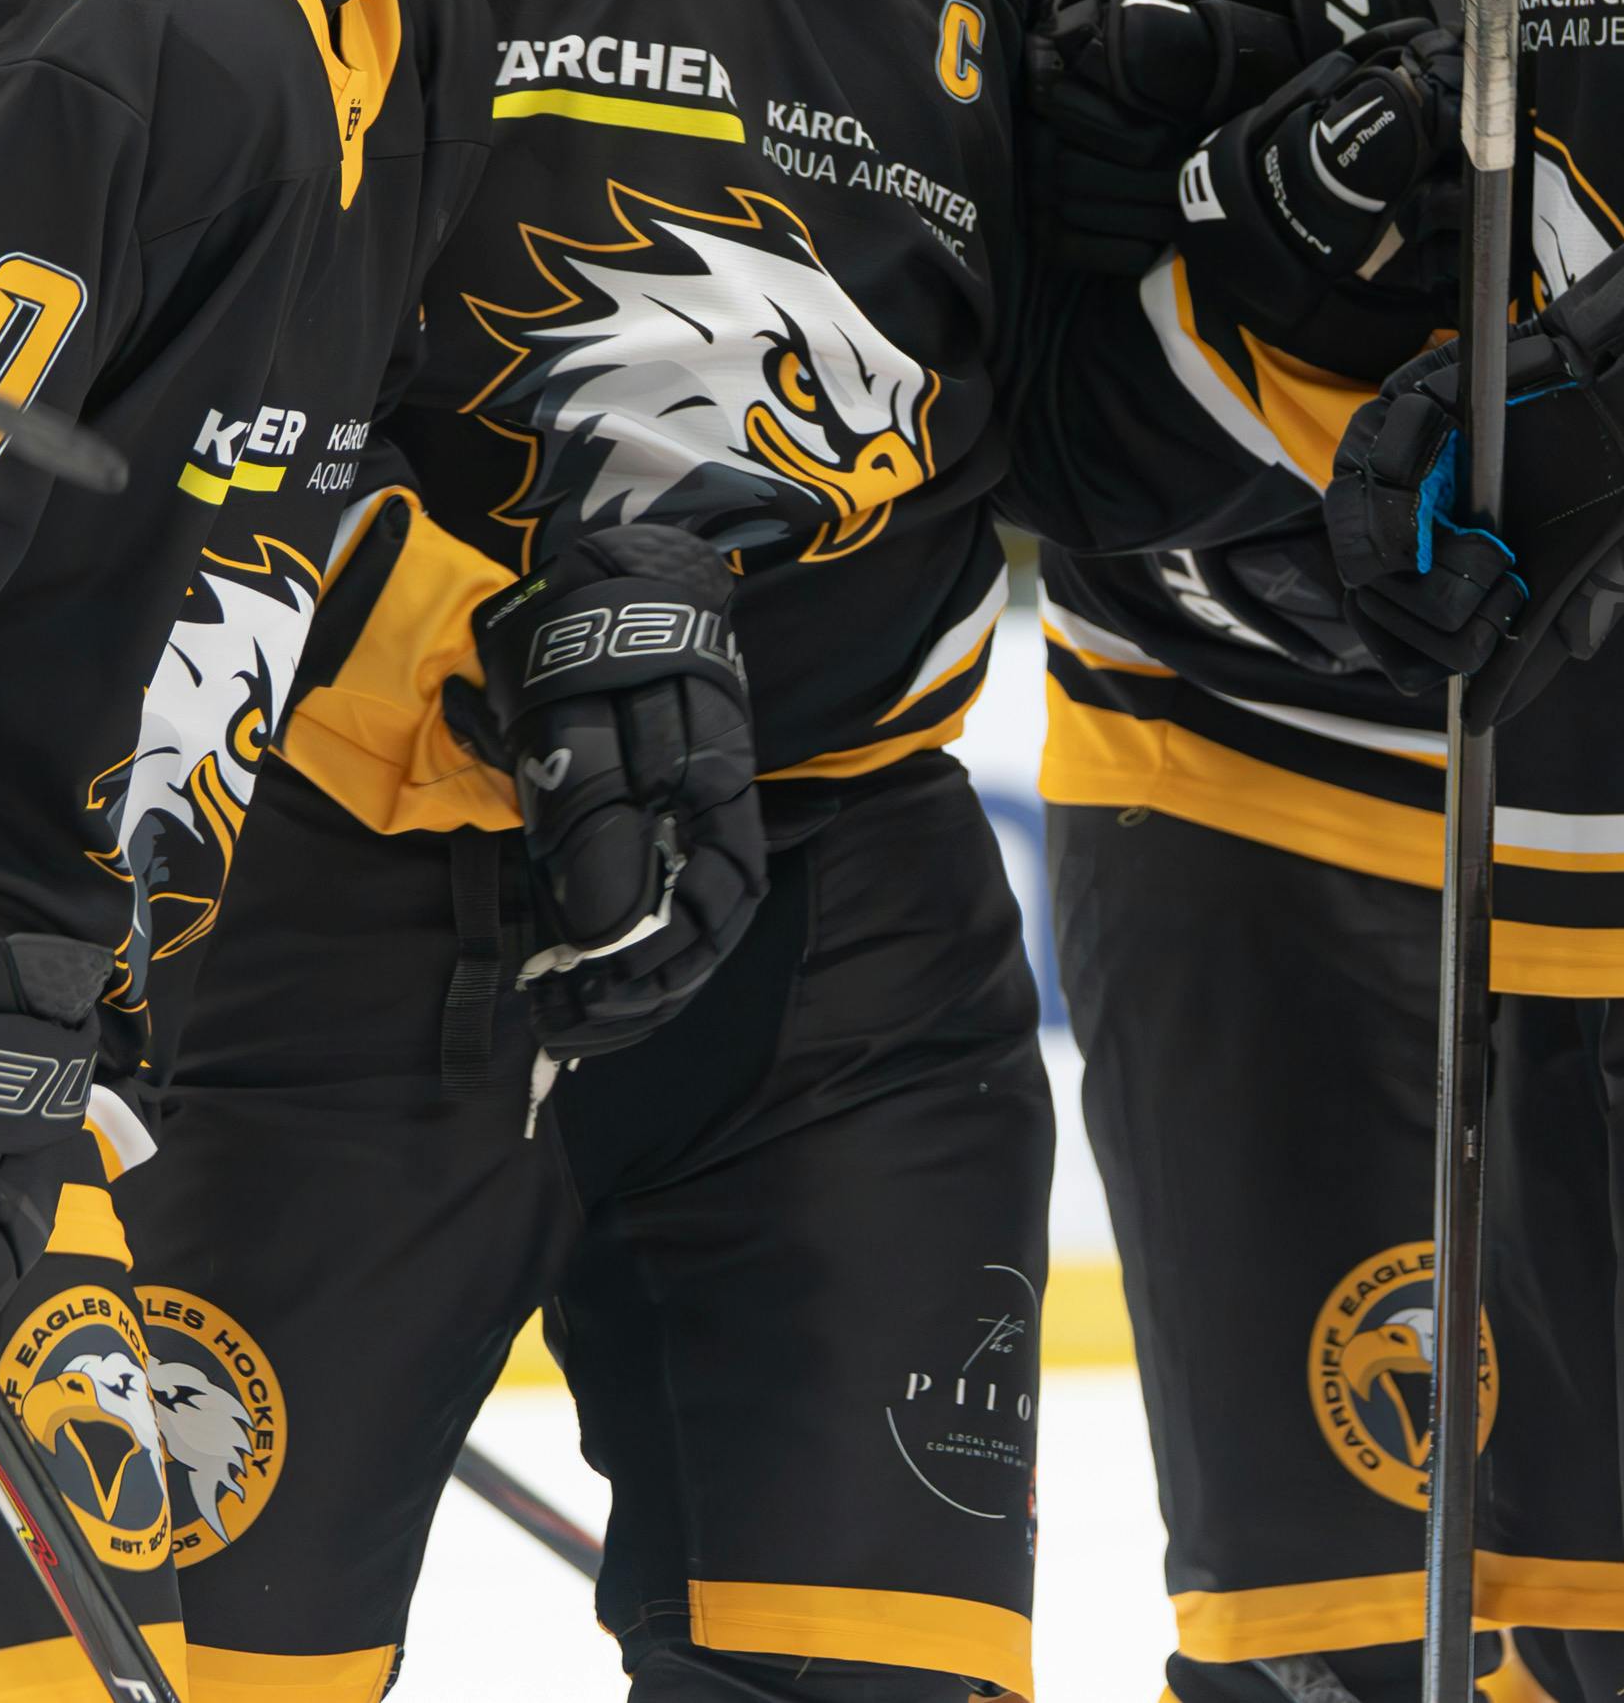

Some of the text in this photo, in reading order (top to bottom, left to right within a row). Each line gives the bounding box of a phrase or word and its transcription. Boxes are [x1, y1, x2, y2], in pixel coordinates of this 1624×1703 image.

[762, 135, 837, 185] AQUA
[1337, 109, 1396, 169] Ergo Thumb
[890, 163, 978, 233] CENTER
[15, 1297, 112, 1369] EAGLES
[213, 1329, 275, 1478] HOCKEY
